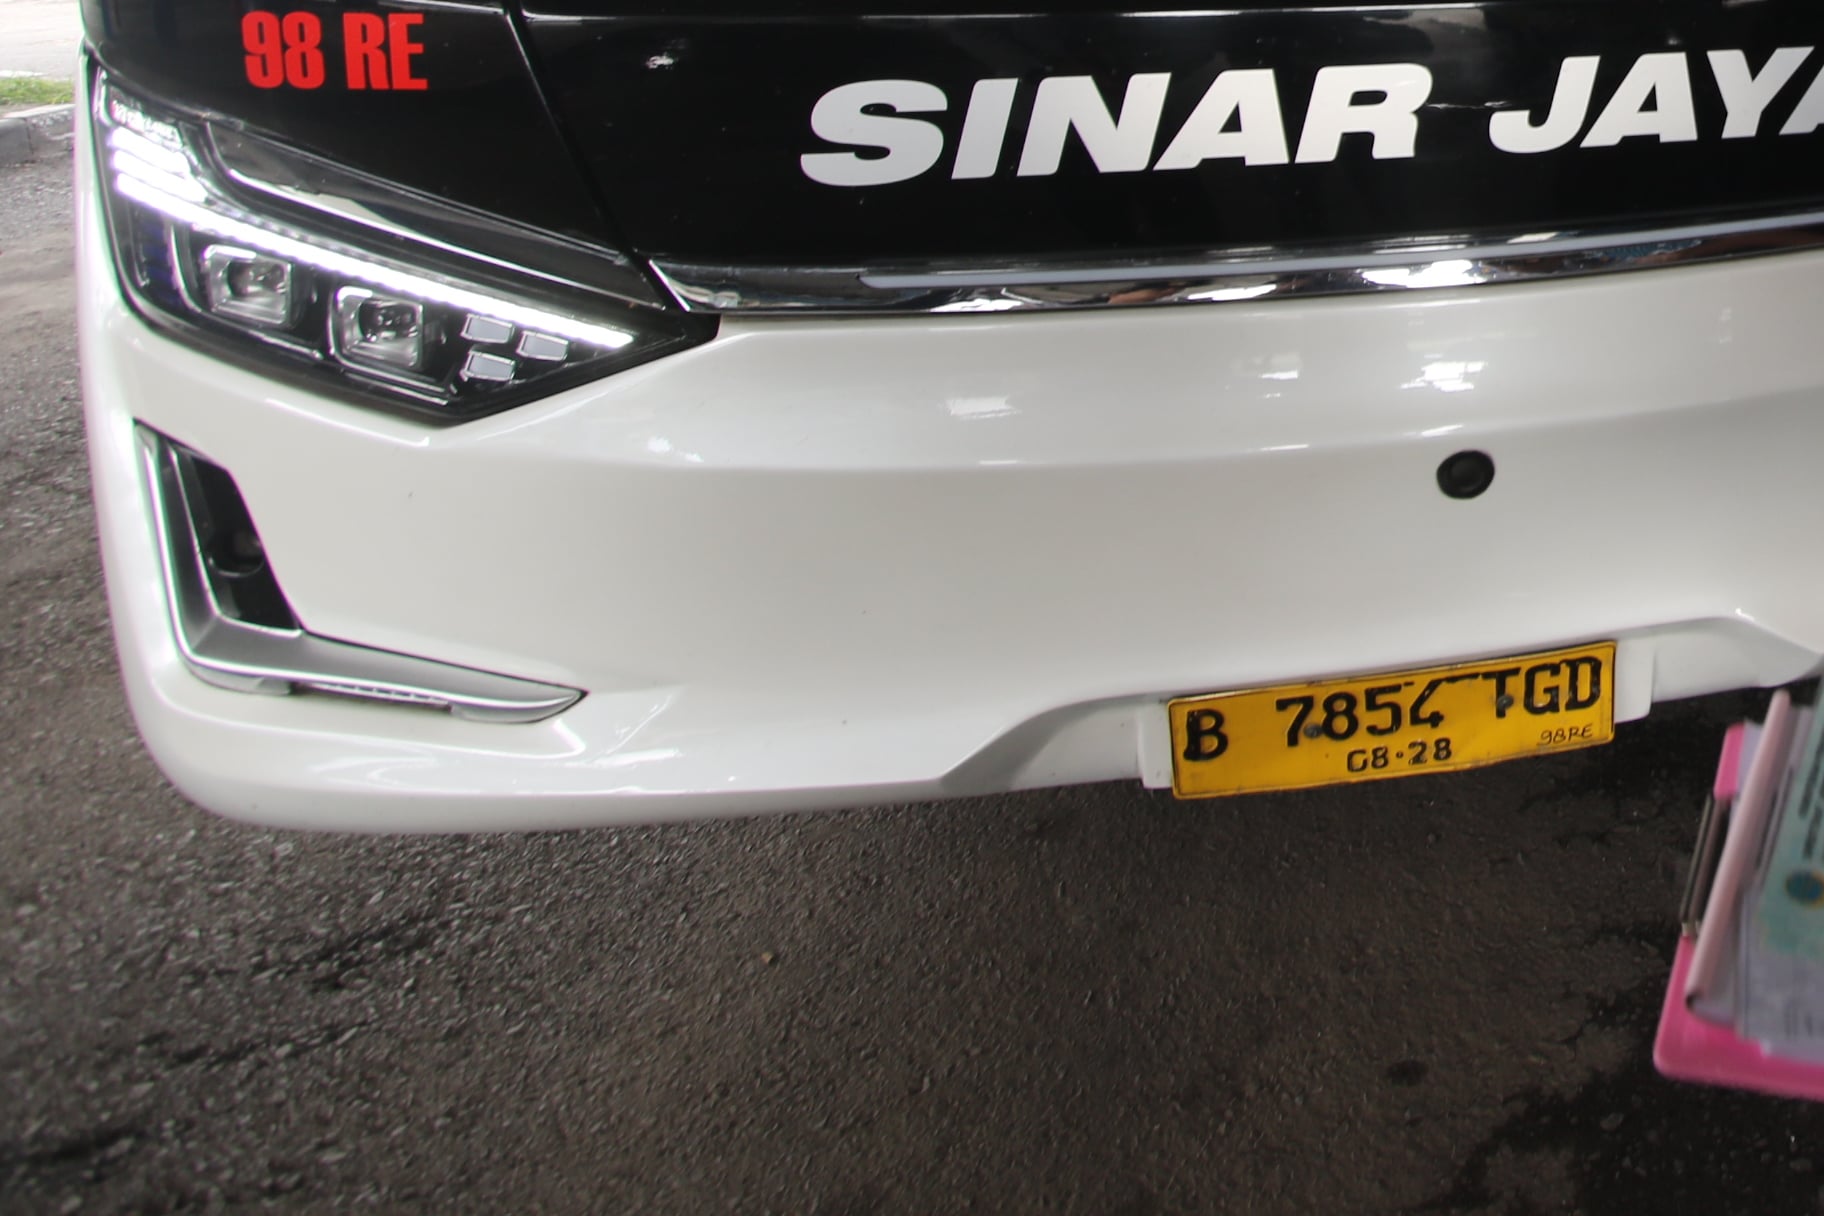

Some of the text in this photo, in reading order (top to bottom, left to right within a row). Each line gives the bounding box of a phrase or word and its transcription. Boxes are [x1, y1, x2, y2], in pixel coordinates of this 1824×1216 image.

[241, 10, 429, 90] 98 RE
[800, 65, 1434, 187] SINAR
[1183, 708, 1228, 762] B
[1483, 656, 1603, 720] TGD
